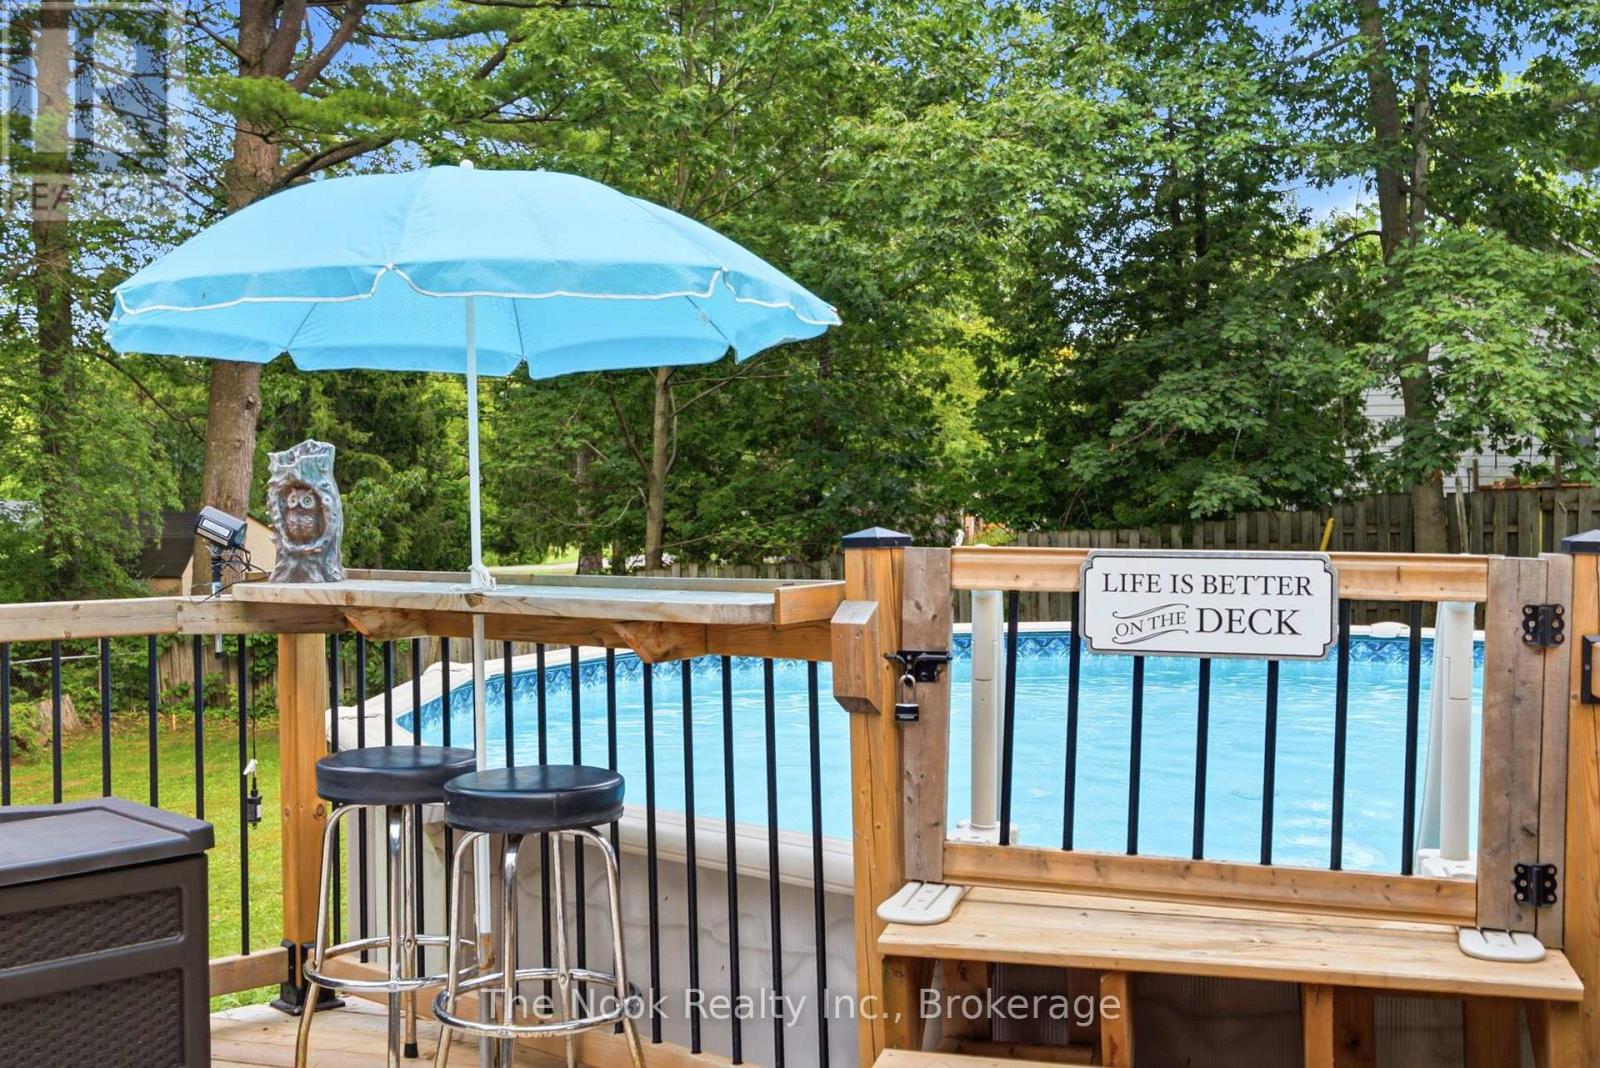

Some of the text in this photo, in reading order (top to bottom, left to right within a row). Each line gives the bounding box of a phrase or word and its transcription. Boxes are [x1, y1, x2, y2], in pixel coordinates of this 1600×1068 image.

[1102, 573, 1314, 597] LIFE IS BETTER
[1115, 607, 1302, 637] ON THE DECK
